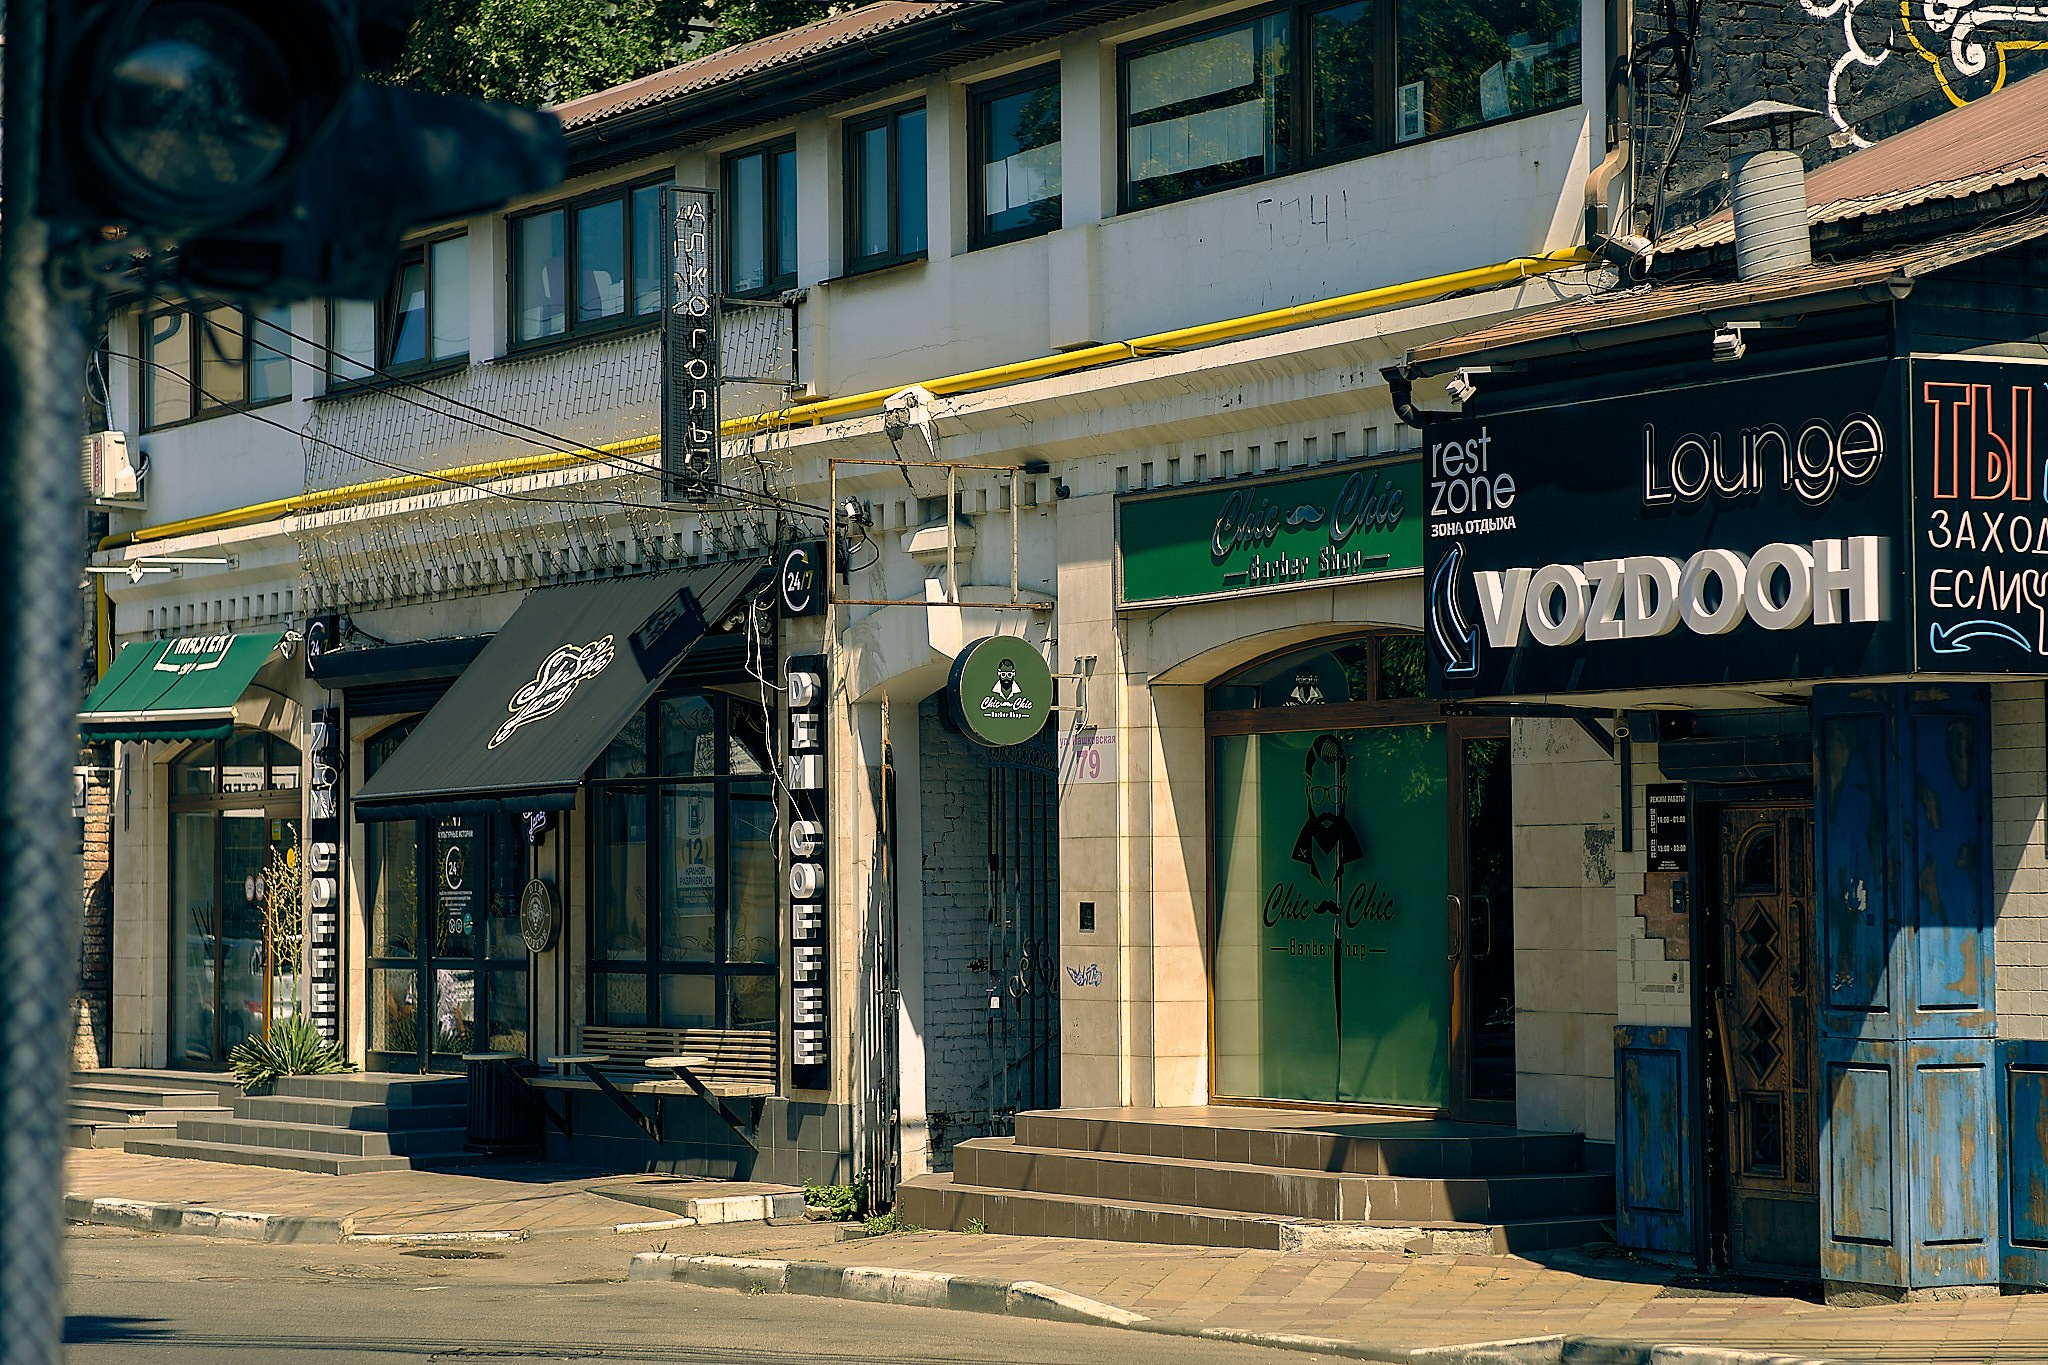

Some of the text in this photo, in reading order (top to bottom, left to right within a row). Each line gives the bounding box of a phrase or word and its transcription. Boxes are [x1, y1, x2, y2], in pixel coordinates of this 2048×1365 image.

[1432, 426, 1492, 478] rest
[1644, 413, 1885, 505] Lounge
[1924, 381, 2033, 500] ТЫ
[1212, 471, 1404, 556] Chic Chic
[1431, 473, 1516, 516] zone
[1431, 516, 1517, 537] ЗОНА ОТДЫХА
[788, 570, 813, 592] 24/7
[1250, 545, 1361, 580] Barber Shop
[1473, 536, 1880, 648] VOZDOOH
[1931, 566, 2021, 613] ЕСЛИ
[981, 696, 1032, 710] Chic Chic
[1072, 735, 1116, 746] Пашковская
[1077, 750, 1100, 779] 79
[1263, 882, 1395, 928] Chic Chic
[789, 820, 825, 1065] COFFEE
[1289, 938, 1367, 960] Barber hop
